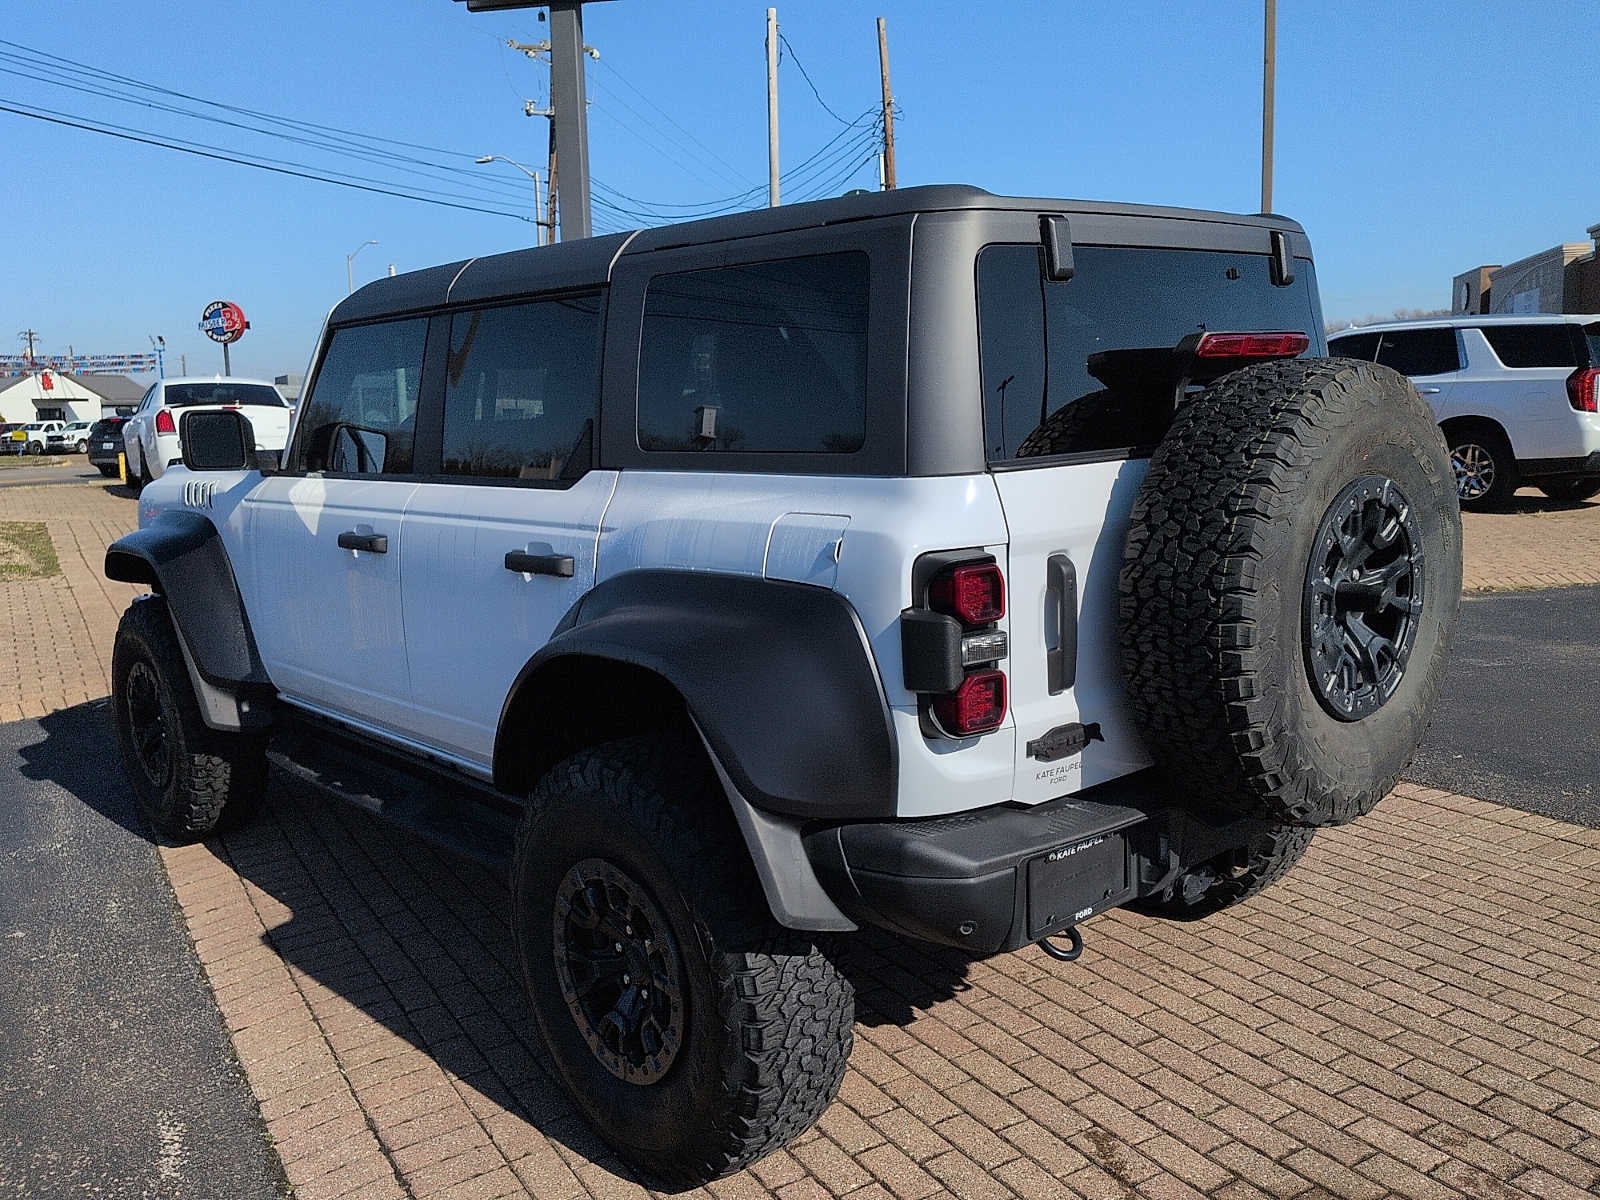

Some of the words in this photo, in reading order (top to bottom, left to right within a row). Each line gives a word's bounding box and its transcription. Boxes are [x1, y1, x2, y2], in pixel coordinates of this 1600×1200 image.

[205, 302, 223, 318] PIZZA
[198, 317, 225, 330] MISTER
[213, 331, 233, 342] WINGS
[1035, 768, 1056, 780] KATE
[1050, 775, 1067, 785] FORD
[1056, 847, 1076, 860] KATE
[1075, 907, 1093, 921] FORD
